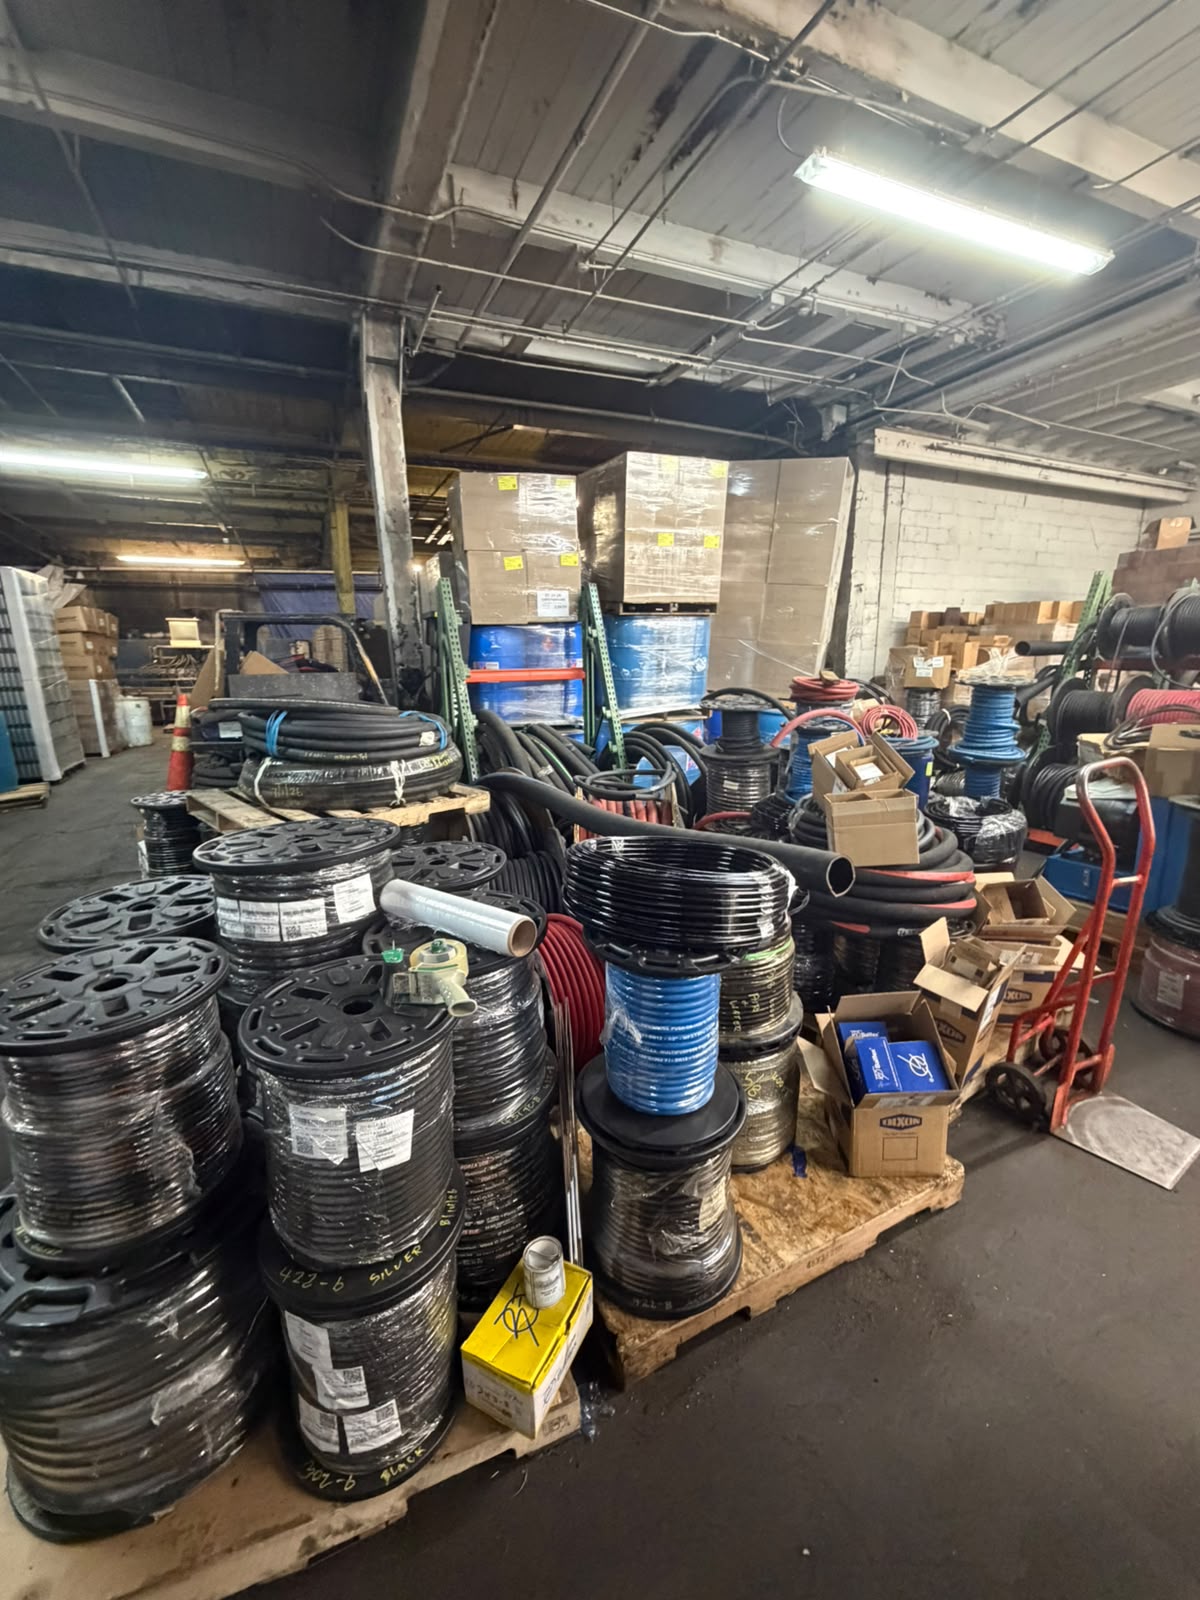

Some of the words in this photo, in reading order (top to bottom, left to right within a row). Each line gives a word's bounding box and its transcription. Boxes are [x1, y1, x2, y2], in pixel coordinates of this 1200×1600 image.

[881, 1115, 921, 1129] DIXON
[279, 1267, 345, 1293] 422-6
[368, 1244, 424, 1287] SILVER
[379, 1445, 426, 1486] BLACK
